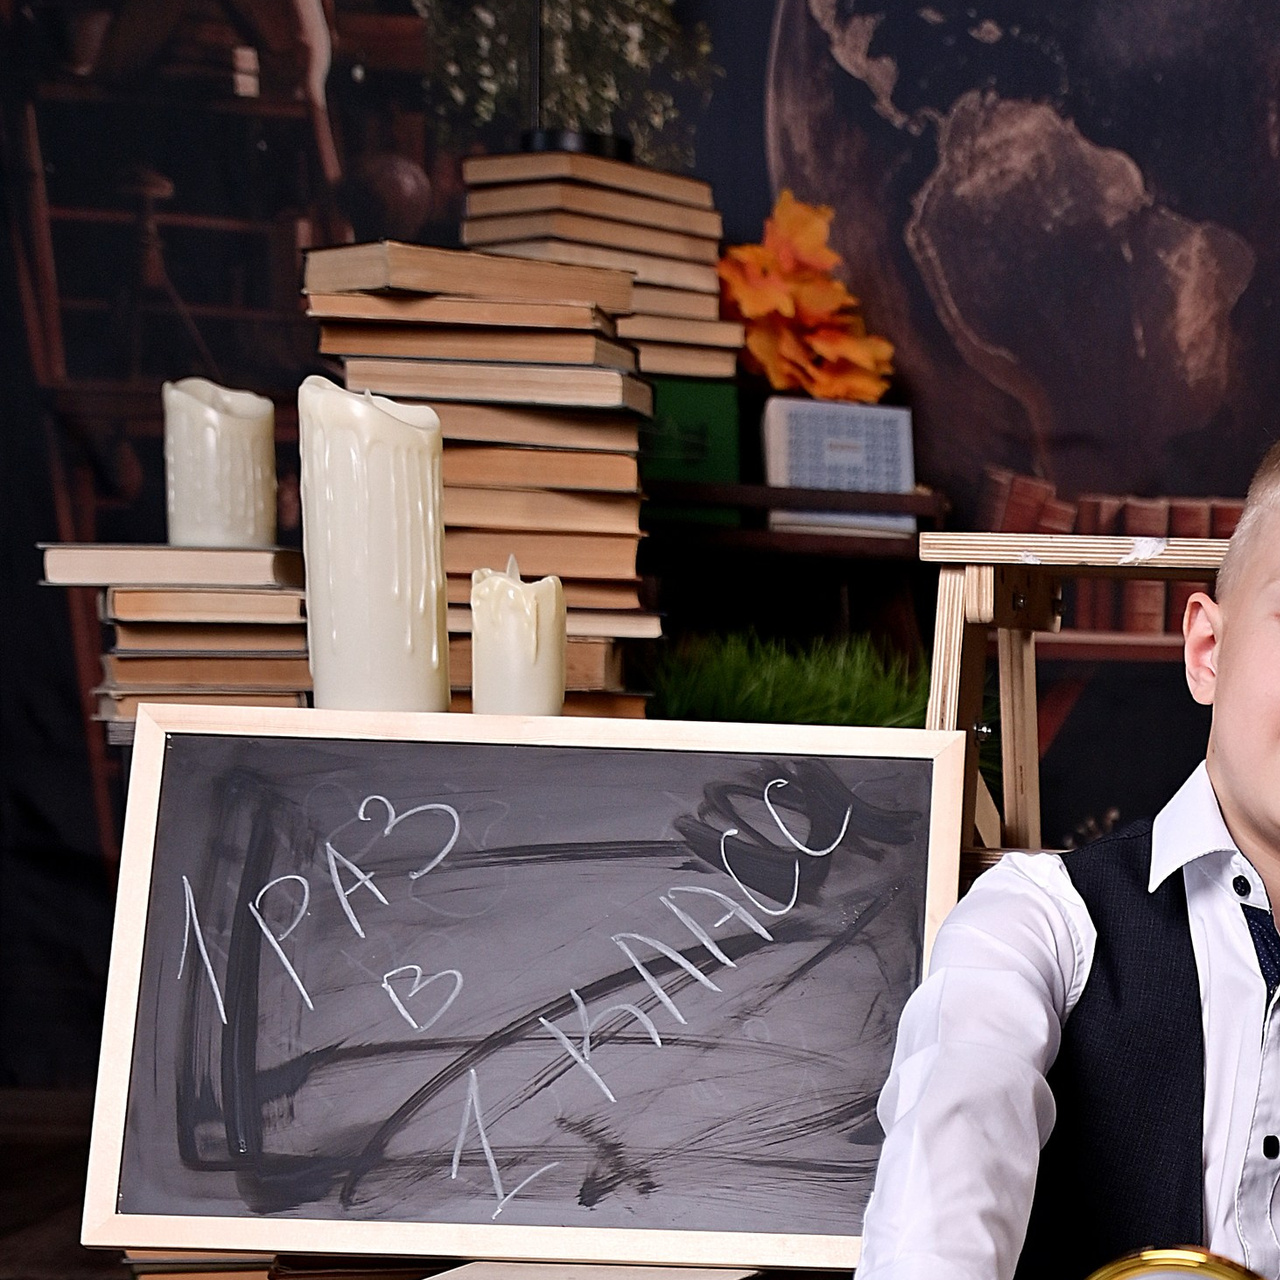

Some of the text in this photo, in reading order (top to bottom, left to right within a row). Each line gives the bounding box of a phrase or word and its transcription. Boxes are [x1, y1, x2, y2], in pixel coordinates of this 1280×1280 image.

[176, 794, 461, 1025] 1 РАЗ
[381, 964, 463, 1033] В
[537, 778, 854, 1104] КЛАСС
